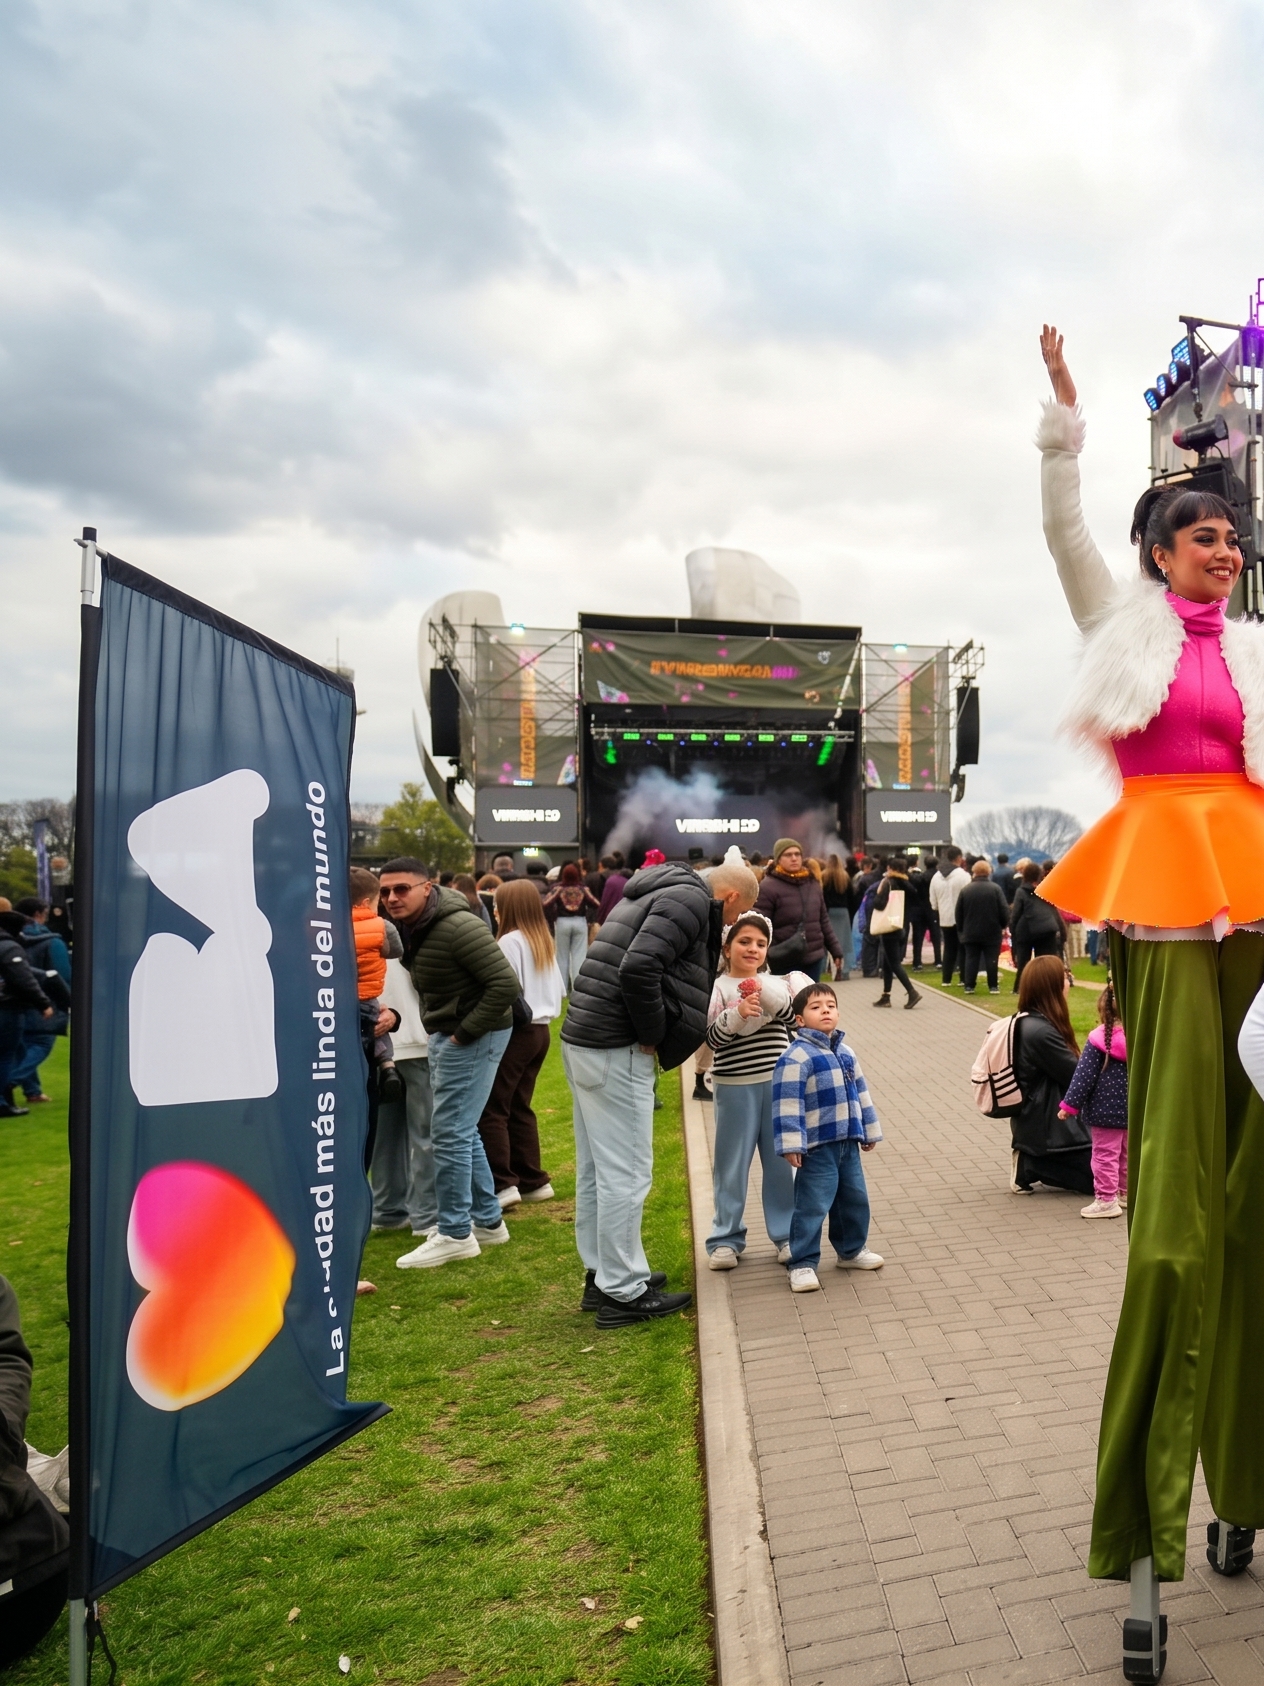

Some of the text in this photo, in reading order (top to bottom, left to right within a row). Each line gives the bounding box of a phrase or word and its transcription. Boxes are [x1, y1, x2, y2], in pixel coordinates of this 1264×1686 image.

[305, 781, 332, 911] mundo
[309, 919, 333, 978] del
[312, 987, 336, 1080] linda
[312, 1091, 336, 1174] más
[326, 1326, 345, 1377] La
